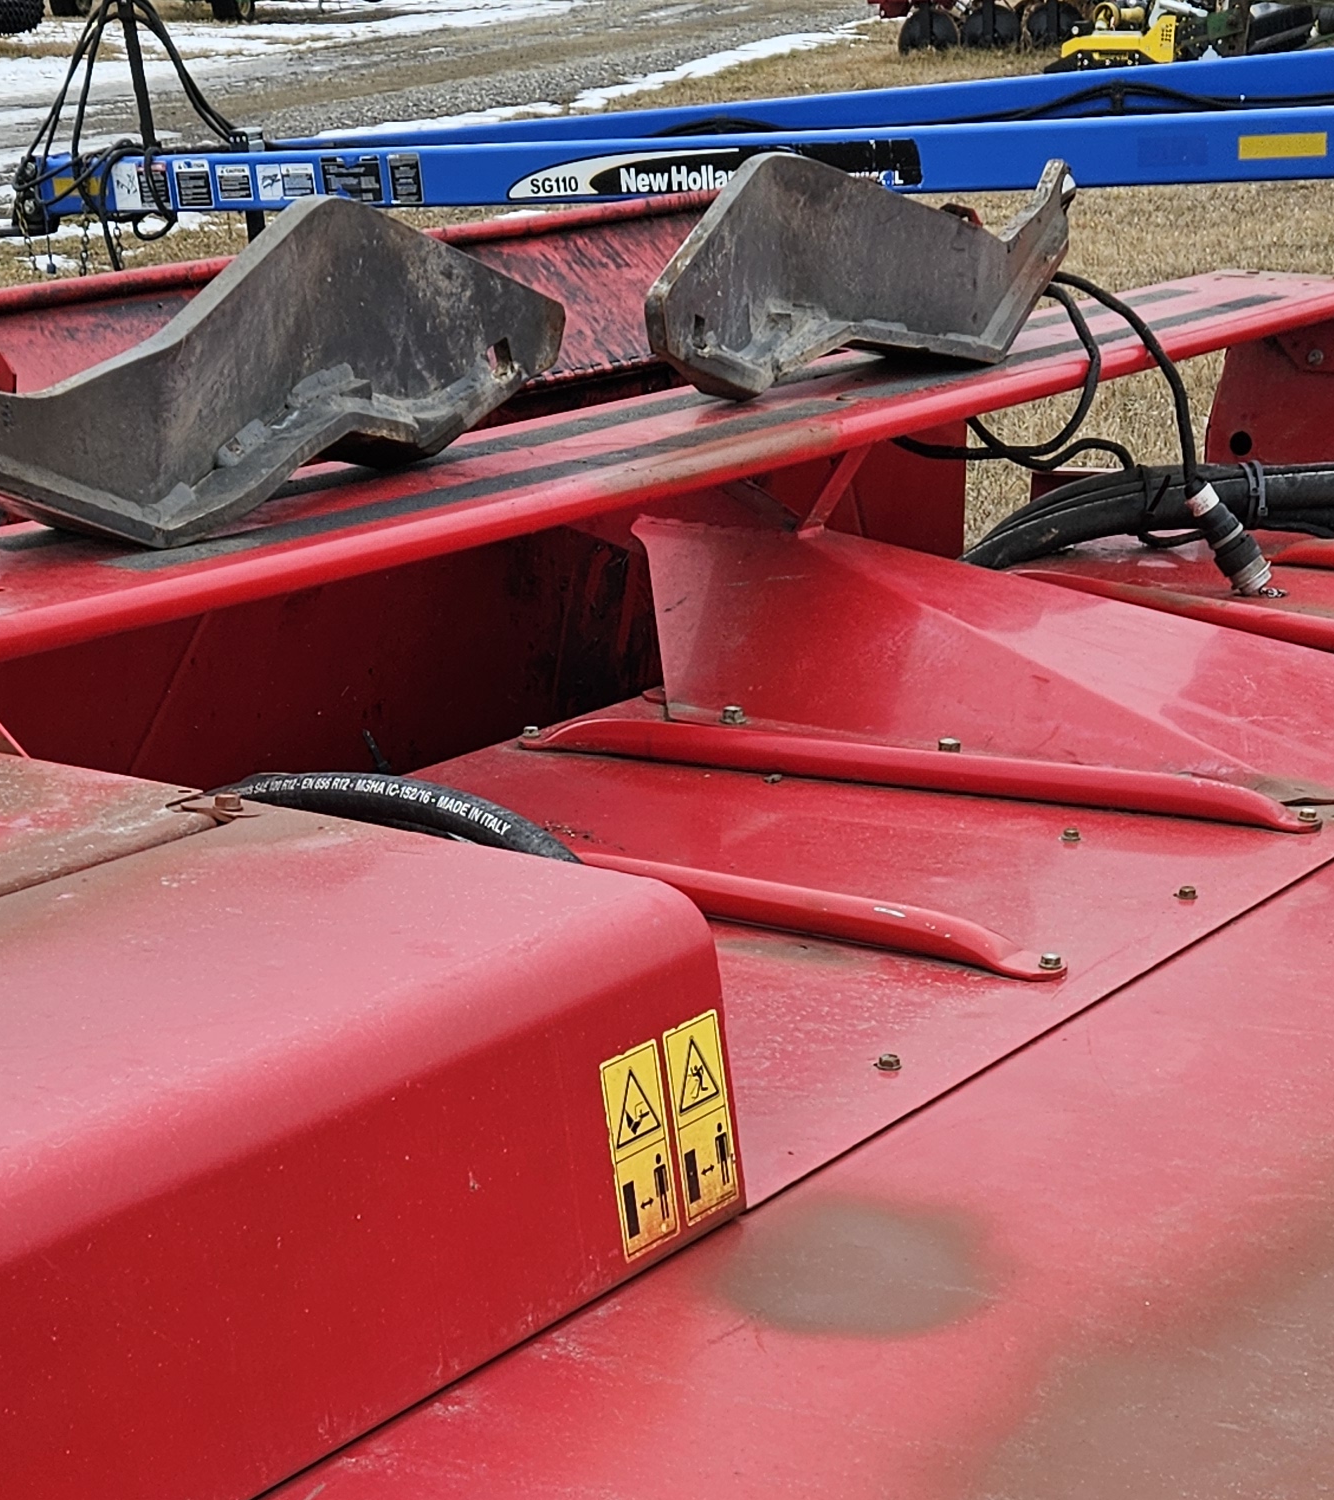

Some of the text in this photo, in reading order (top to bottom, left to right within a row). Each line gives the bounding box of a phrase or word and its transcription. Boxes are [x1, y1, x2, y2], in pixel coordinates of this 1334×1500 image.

[530, 176, 579, 194] SG110
[619, 167, 670, 192] New
[331, 777, 351, 791] R12
[354, 779, 384, 794] MSHA
[384, 783, 432, 805] IC-152/16
[436, 795, 470, 817] MADE
[468, 805, 485, 822] IN
[479, 812, 512, 836] ITALY
